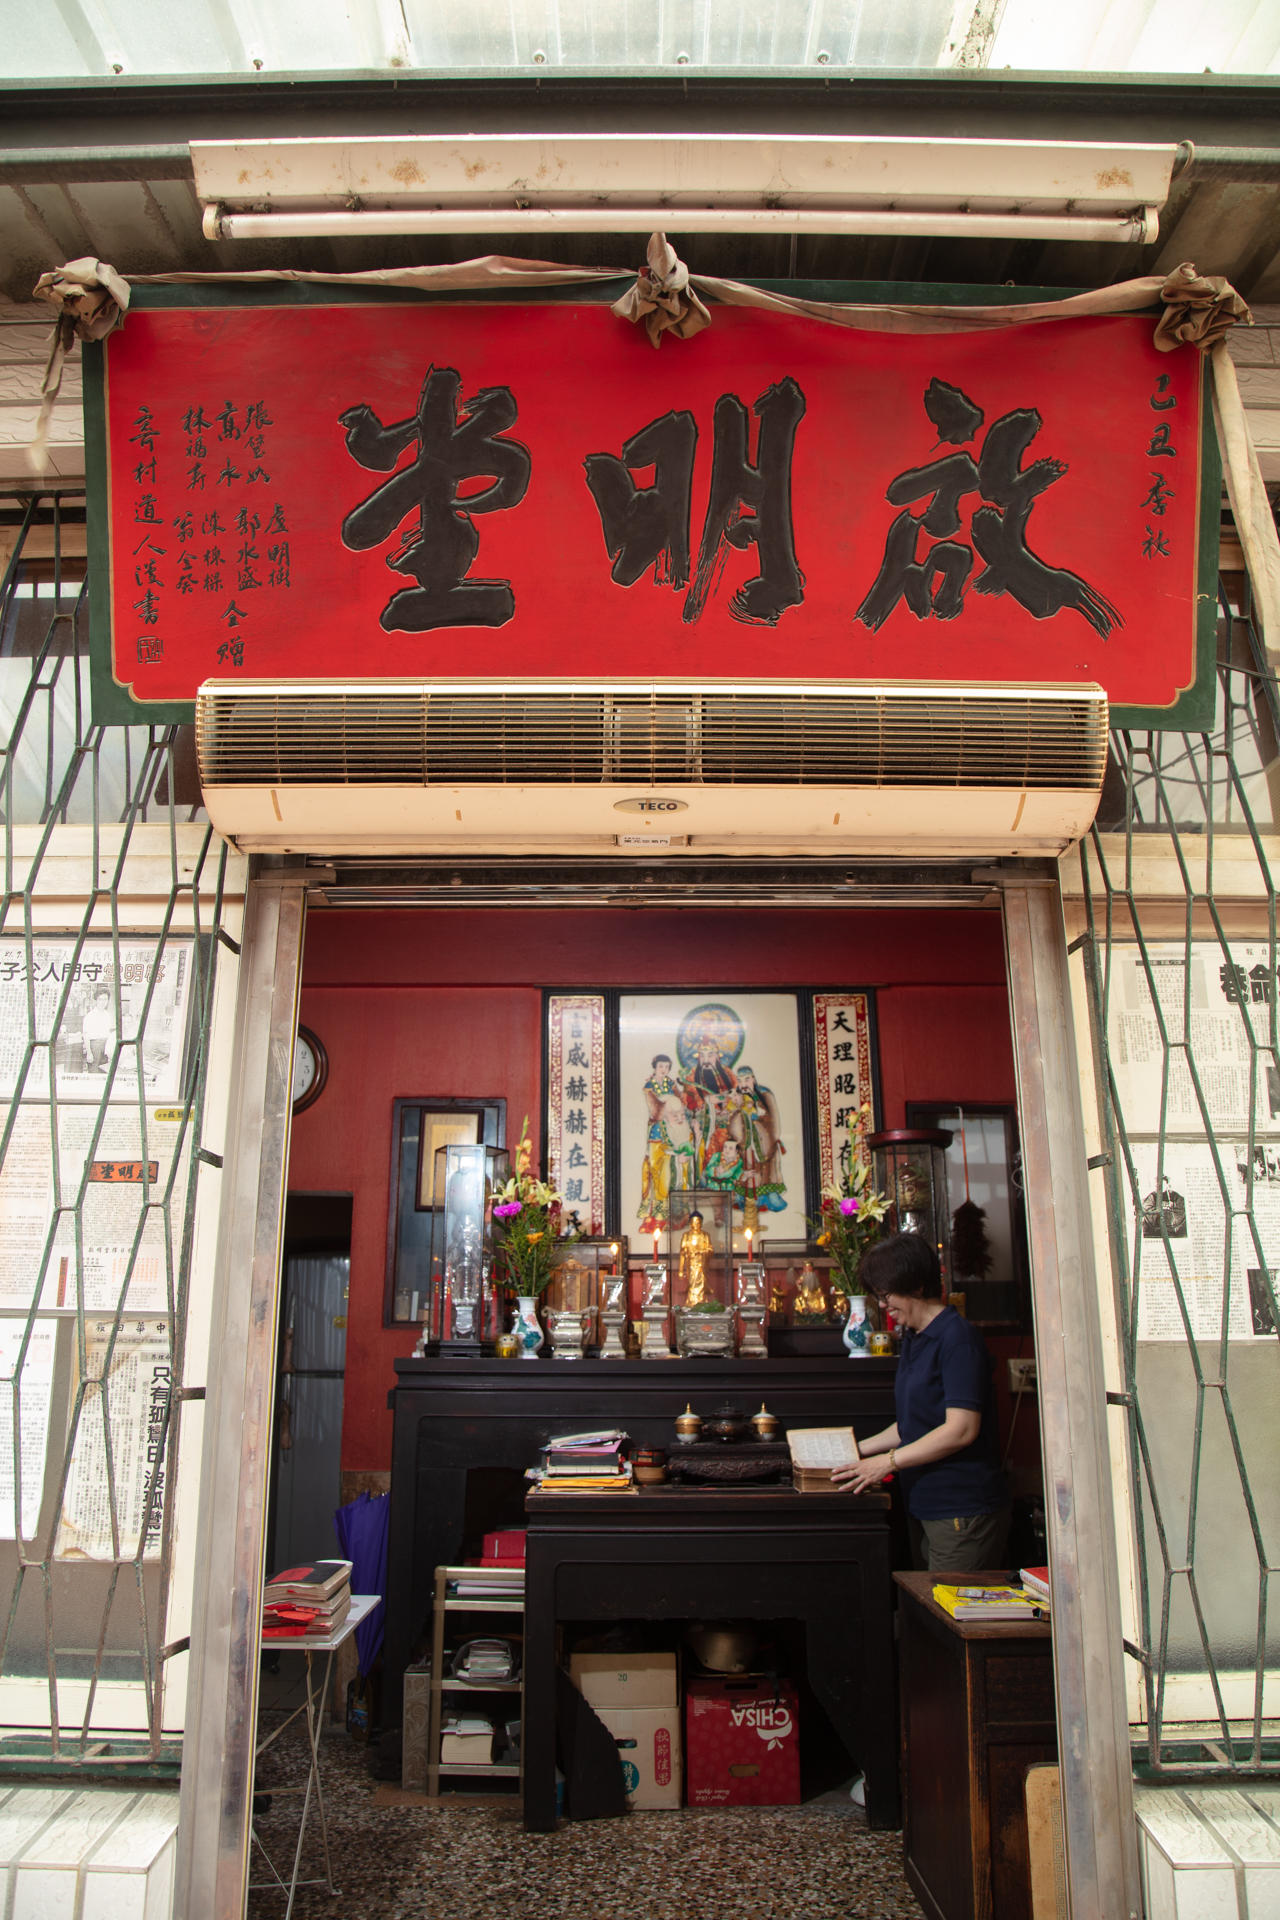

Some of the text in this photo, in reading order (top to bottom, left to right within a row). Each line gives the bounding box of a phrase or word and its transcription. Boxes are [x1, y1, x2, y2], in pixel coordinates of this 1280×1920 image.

[638, 802, 678, 811] TECO
[830, 1010, 857, 1197] 天理昭昭存
[617, 1673, 628, 1682] 20
[730, 1708, 790, 1727] CHISA
[655, 1731, 670, 1785] 秋節佳果
